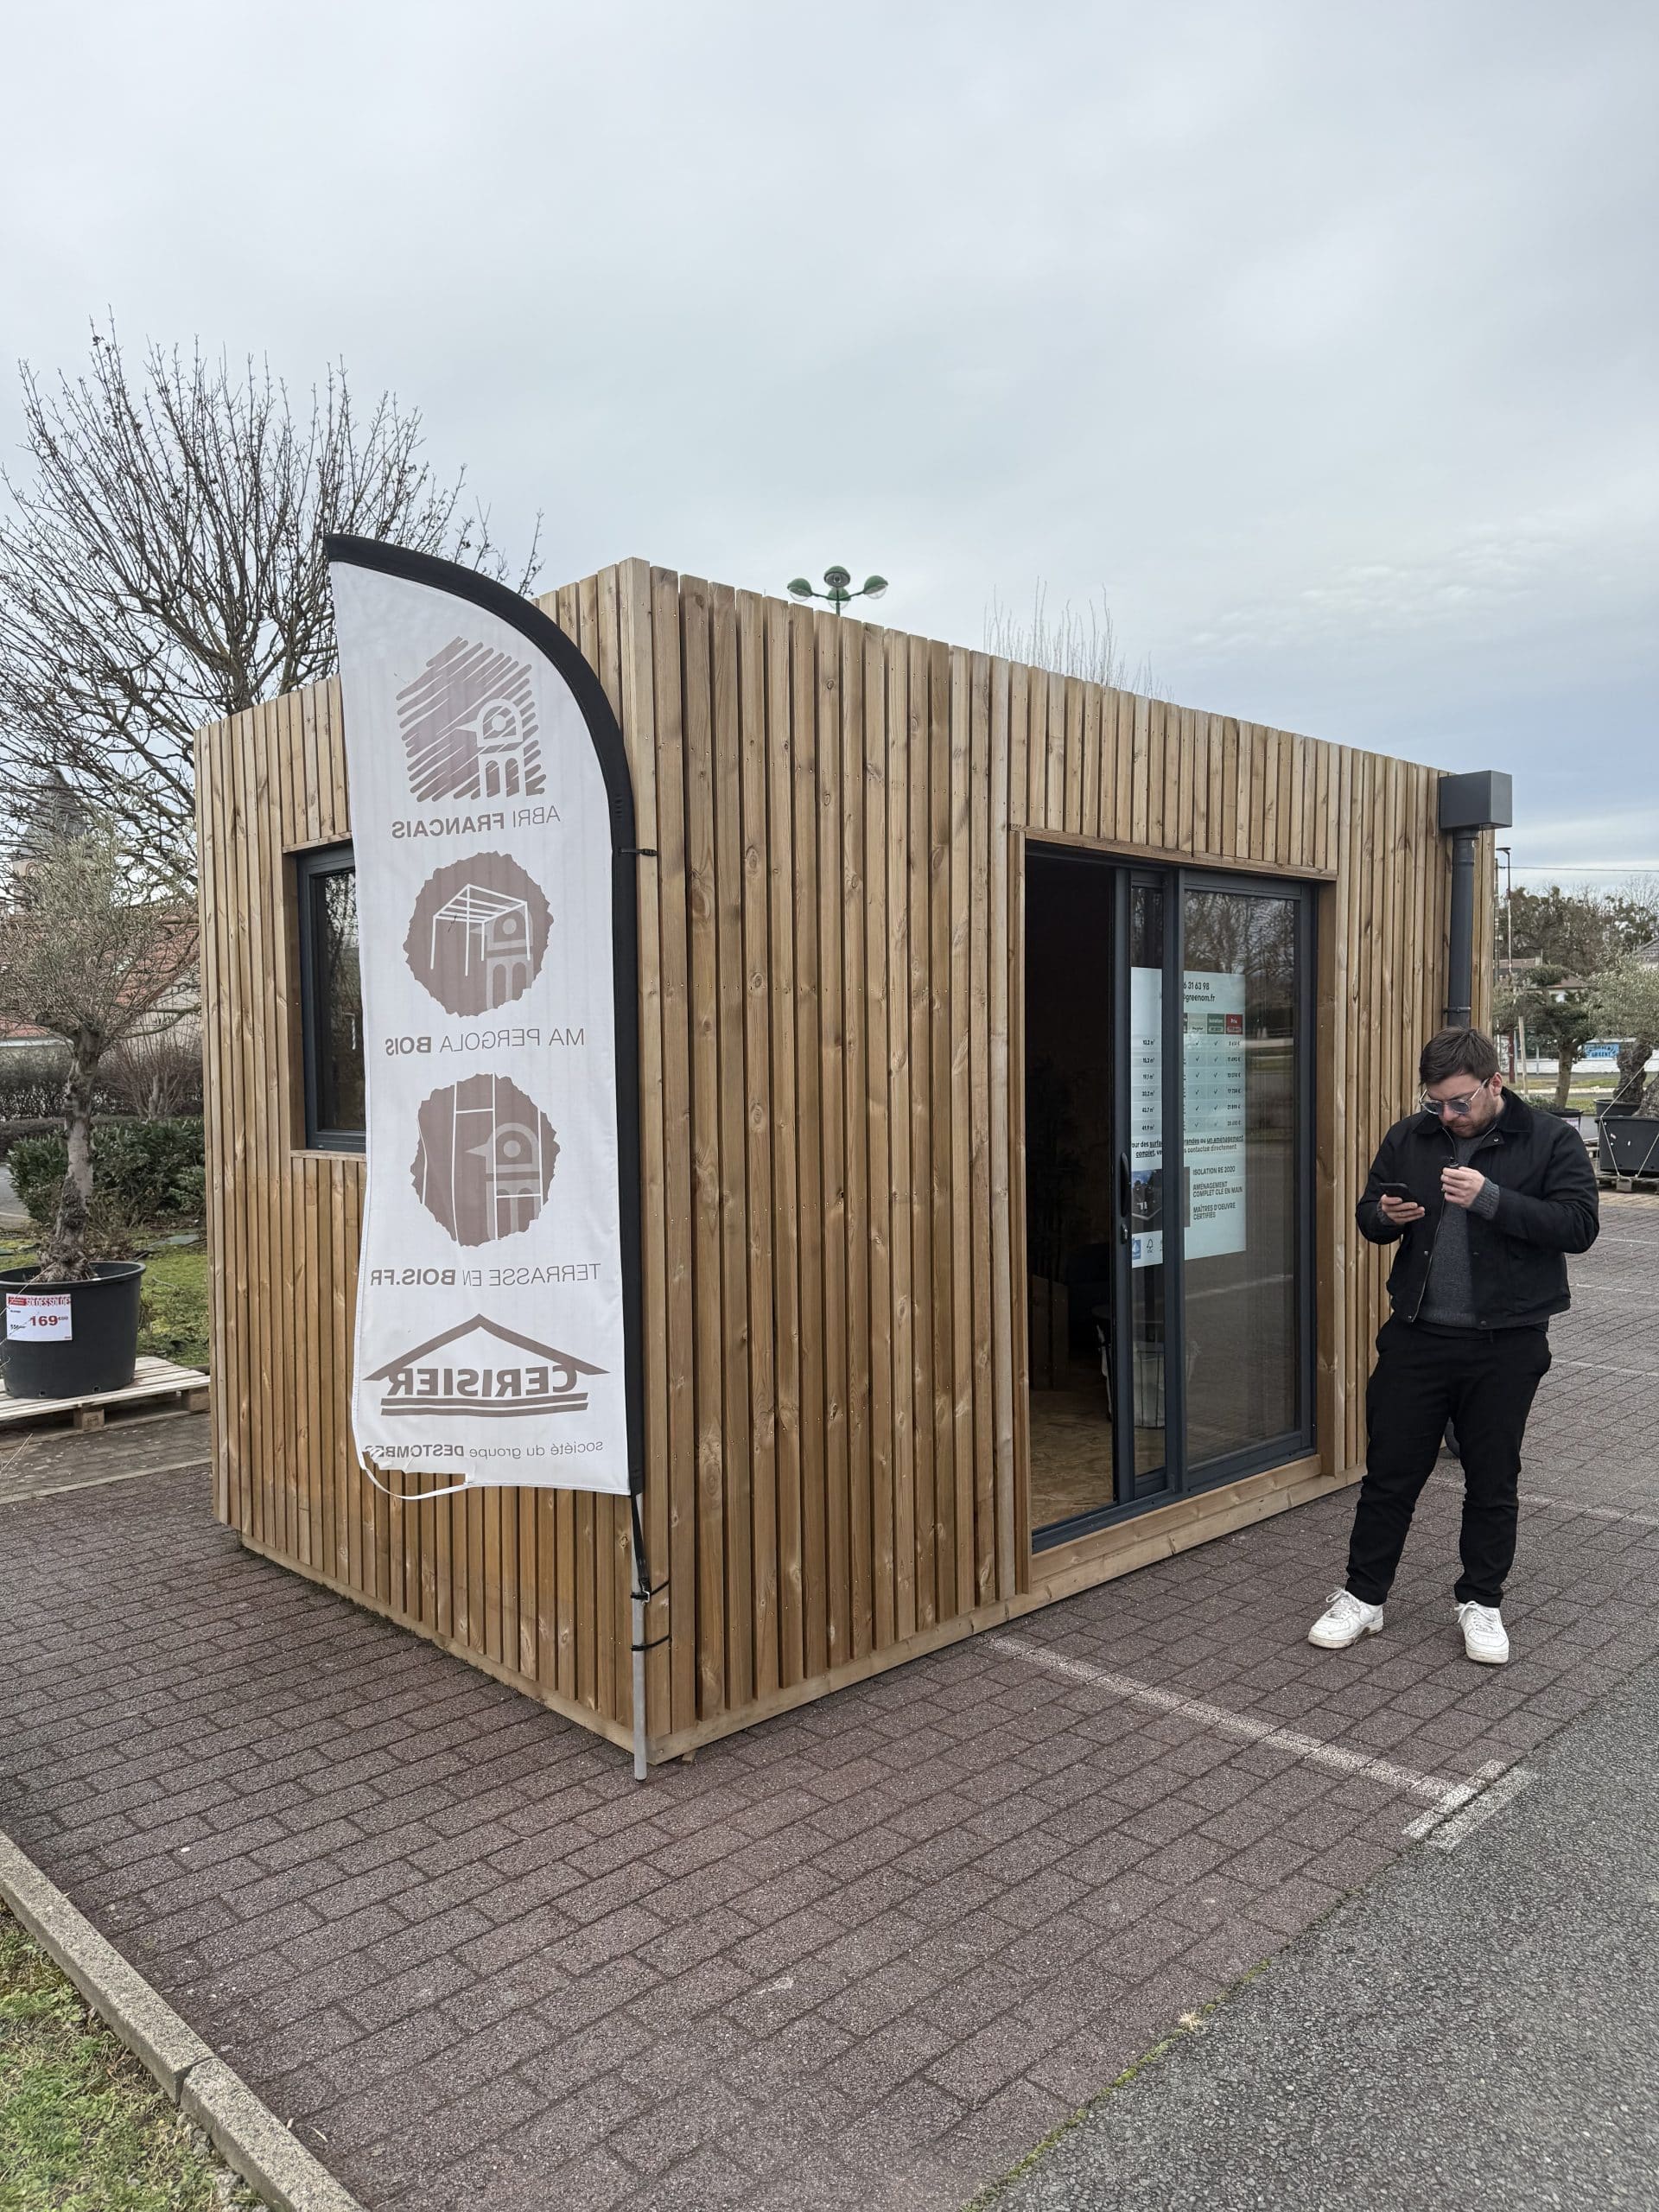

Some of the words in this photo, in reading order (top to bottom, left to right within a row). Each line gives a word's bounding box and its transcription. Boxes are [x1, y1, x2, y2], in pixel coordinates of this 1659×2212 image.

[1192, 1167, 1217, 1176] ISOLATION
[1192, 1189, 1214, 1198] COMPLET
[48, 1297, 71, 1306] SOLDE
[30, 1315, 58, 1326] 169
